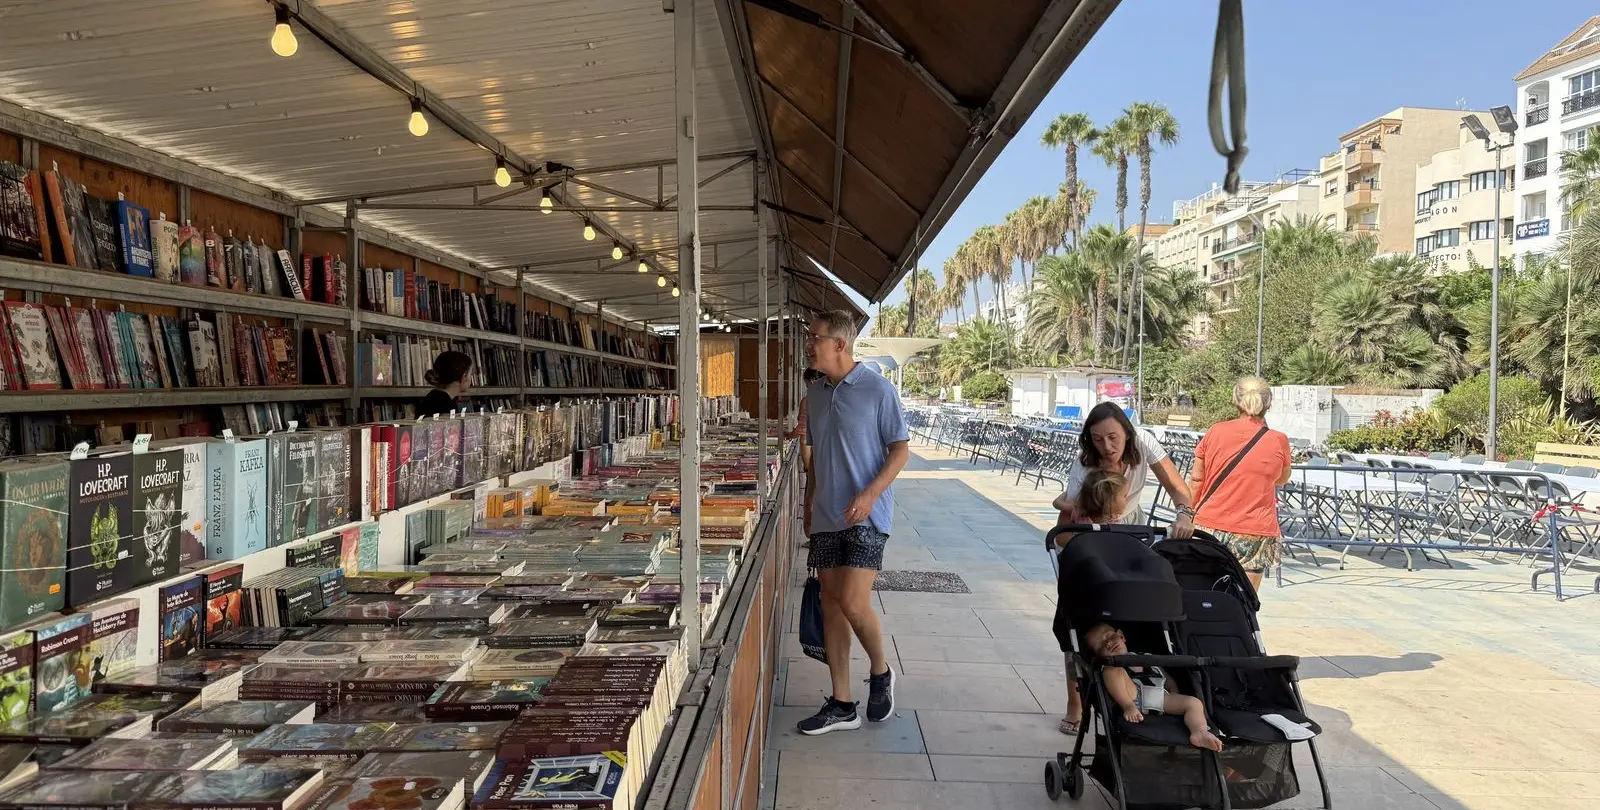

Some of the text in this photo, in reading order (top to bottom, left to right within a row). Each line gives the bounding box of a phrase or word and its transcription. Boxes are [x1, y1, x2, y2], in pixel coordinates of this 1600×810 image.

[184, 452, 200, 464] RRA
[245, 448, 260, 458] FRANZ
[97, 463, 113, 478] H.P.
[155, 458, 168, 472] H.P.
[240, 457, 265, 473] KAFKA
[80, 475, 129, 497] LOVECRAFT
[141, 470, 180, 489] LOVECRAFT
[12, 482, 40, 500] OSCAR
[213, 466, 221, 538] FRANZ KAFKA
[101, 614, 120, 625] Aventuras
[41, 635, 79, 653] Robinson Crusoe
